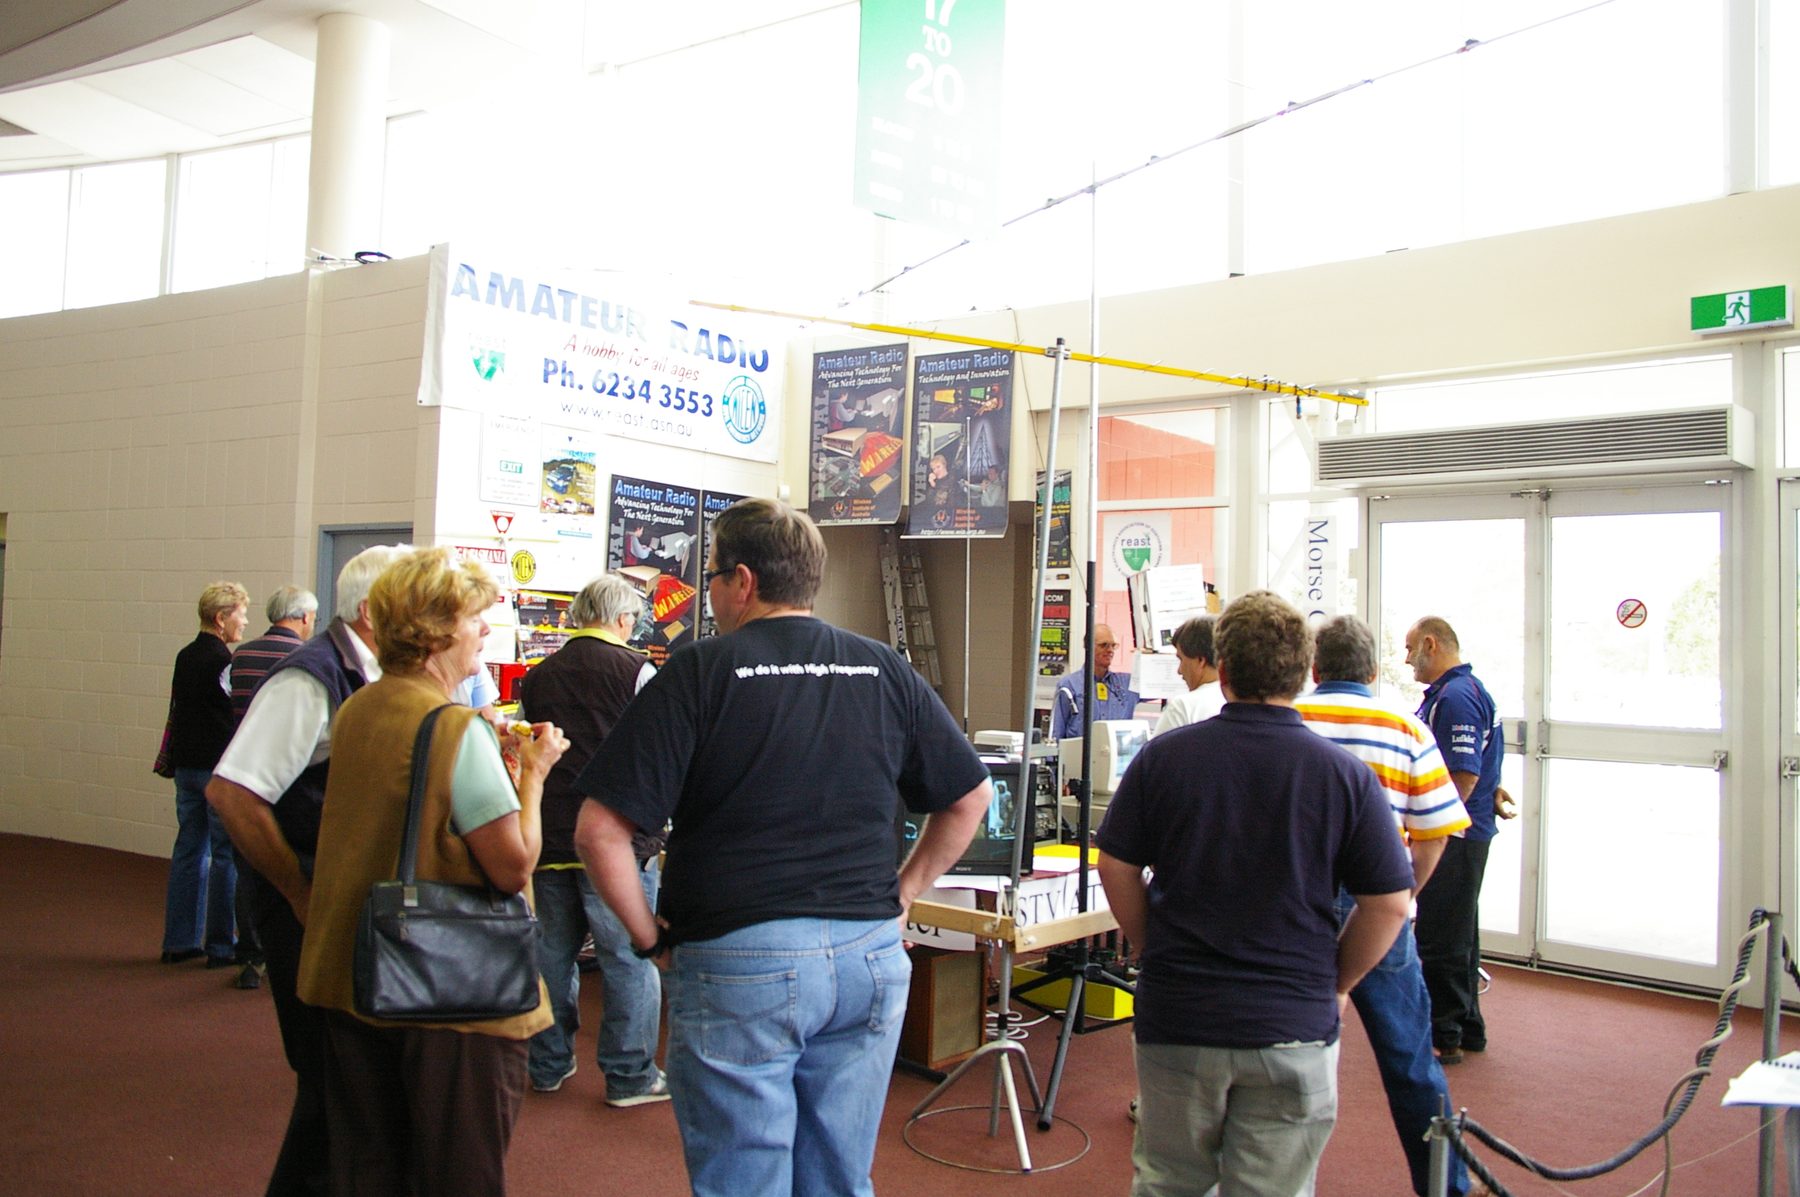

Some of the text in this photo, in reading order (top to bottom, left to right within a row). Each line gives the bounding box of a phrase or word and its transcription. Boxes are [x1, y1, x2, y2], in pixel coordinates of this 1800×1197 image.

[922, 24, 952, 57] TO
[905, 52, 965, 116] 20
[451, 262, 646, 343] AMATEUR
[564, 334, 577, 352] A
[671, 363, 700, 382] ages
[818, 348, 903, 370] Amateur Radio
[919, 351, 1009, 373] Amateur Radio
[818, 364, 902, 381] Advancing Technology For
[828, 376, 892, 389] The Next Generation
[919, 367, 1009, 386] Technology and Innovation
[543, 356, 713, 417] Ph. 6234 3553
[501, 461, 522, 473] EXIT
[615, 479, 663, 501] Amateur
[665, 487, 697, 507] Radio
[704, 494, 736, 510] Amate
[614, 496, 694, 519] Advancing Technology For
[623, 509, 685, 525] The Next Generation
[1121, 535, 1151, 547] reast
[1308, 520, 1328, 600] Morse
[735, 663, 879, 679] We do it with High Frequency
